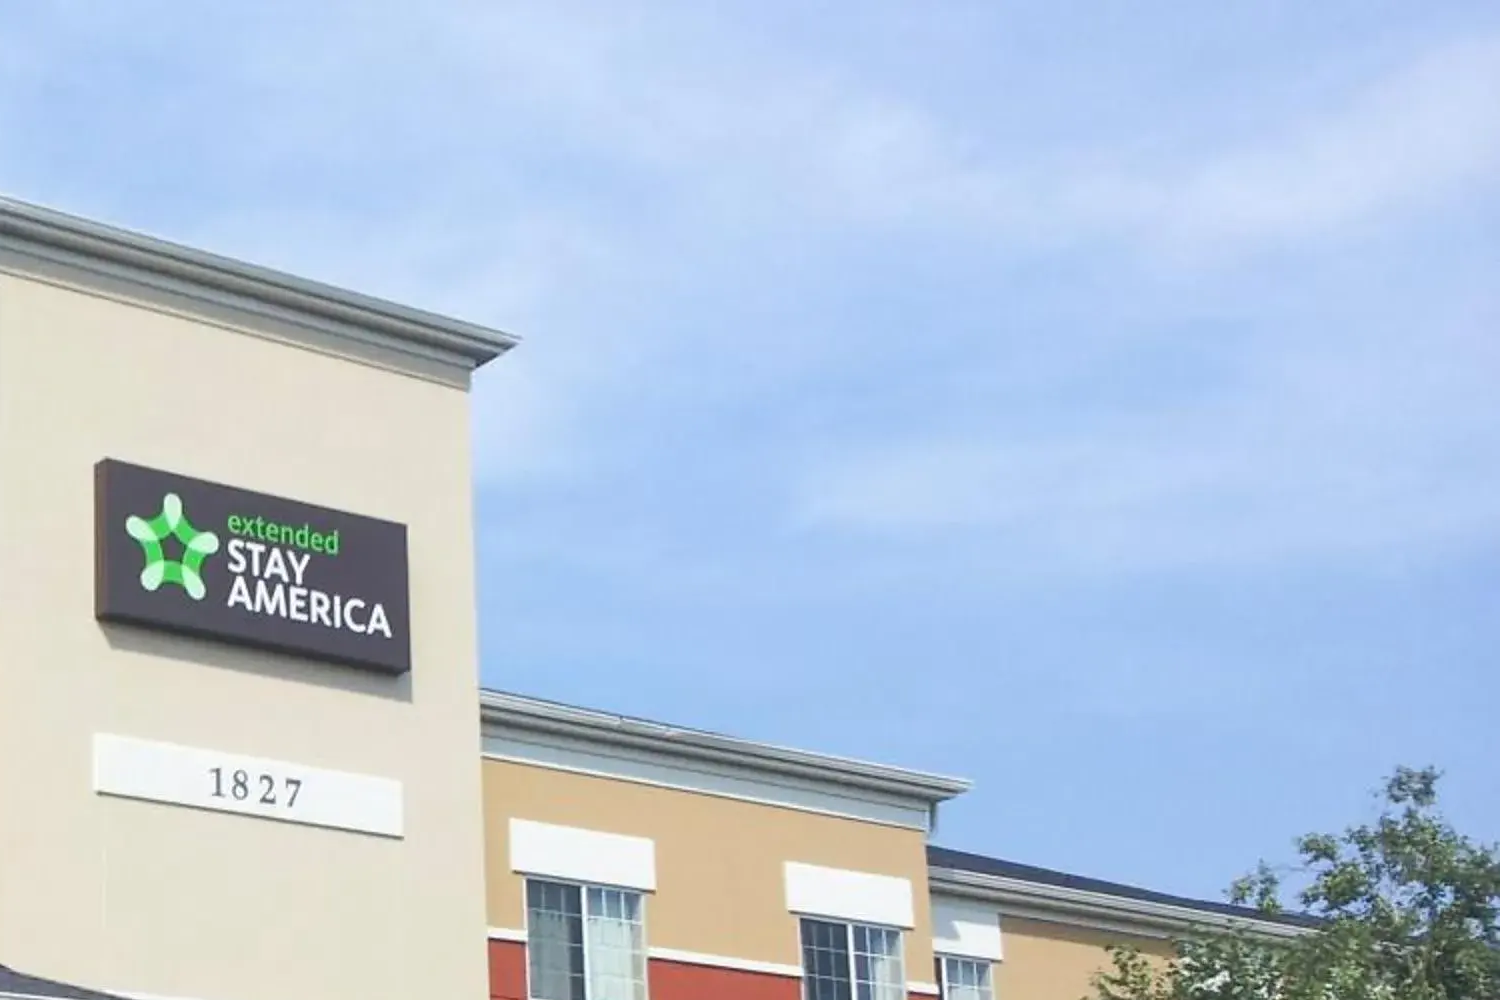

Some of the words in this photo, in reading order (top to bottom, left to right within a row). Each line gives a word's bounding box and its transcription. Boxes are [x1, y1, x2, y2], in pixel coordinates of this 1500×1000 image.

[227, 514, 339, 555] extended
[227, 538, 311, 585] STAY
[227, 575, 393, 638] AMERICA
[209, 767, 302, 808] 1827
